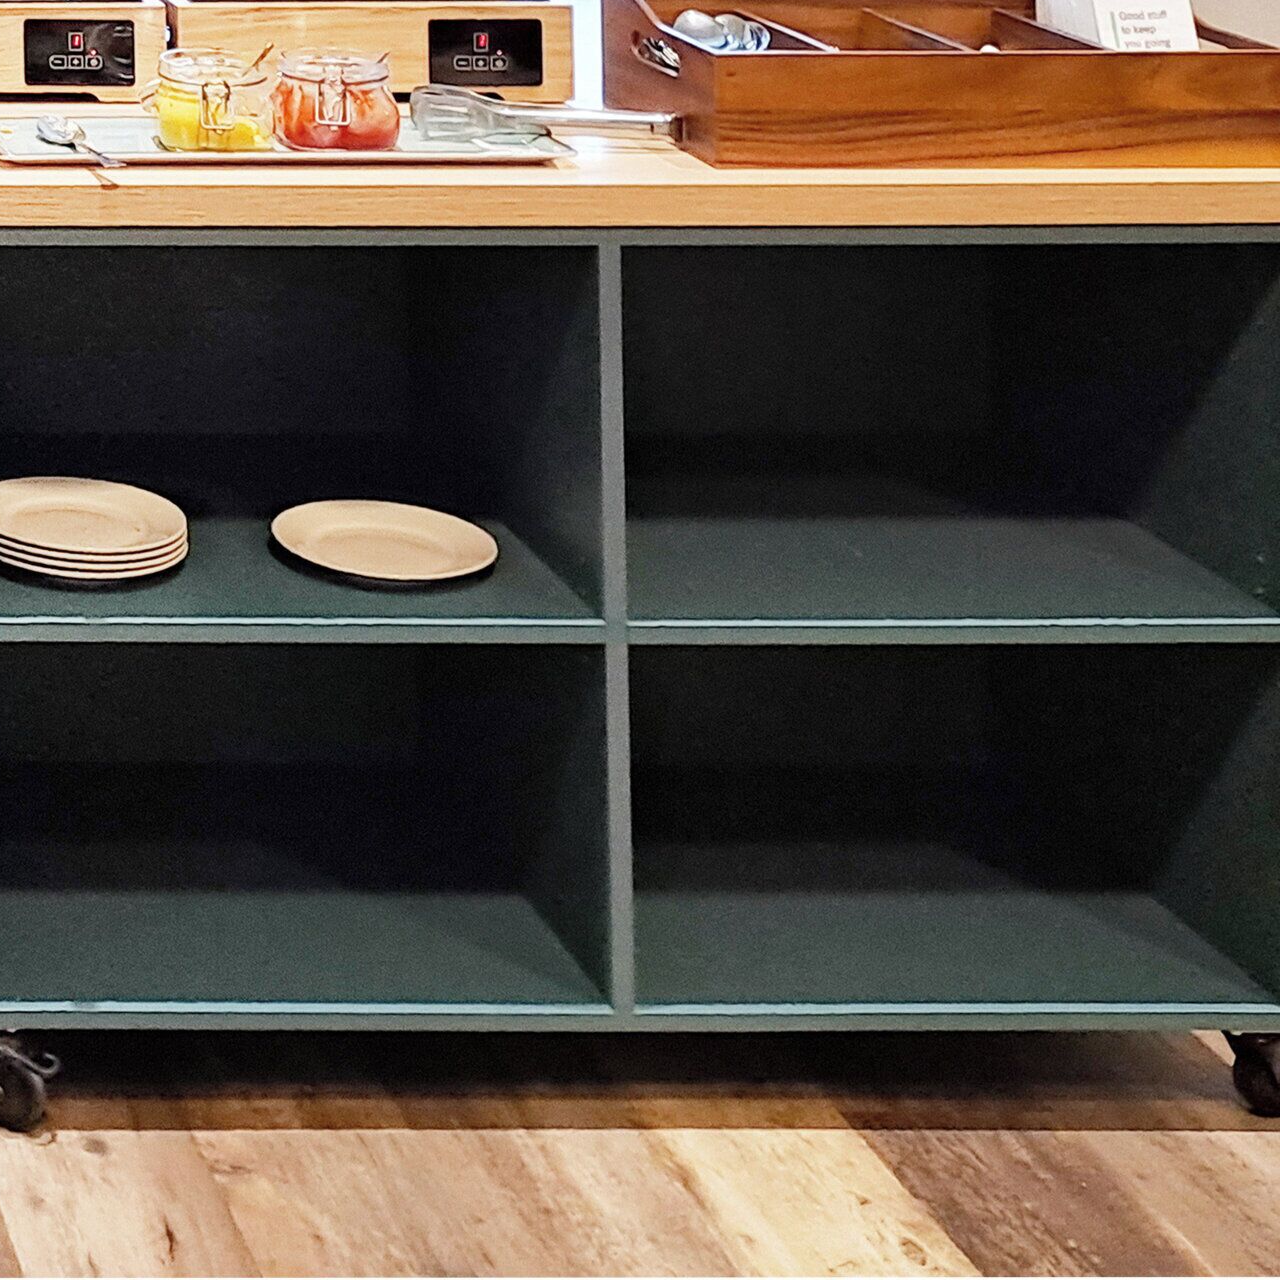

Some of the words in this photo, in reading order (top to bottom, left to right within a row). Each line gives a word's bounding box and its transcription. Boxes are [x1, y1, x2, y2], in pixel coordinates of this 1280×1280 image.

[1119, 11, 1144, 21] Good
[1121, 26, 1131, 35] to
[1133, 25, 1156, 35] keep
[1124, 41, 1142, 49] you
[1145, 40, 1171, 49] going
